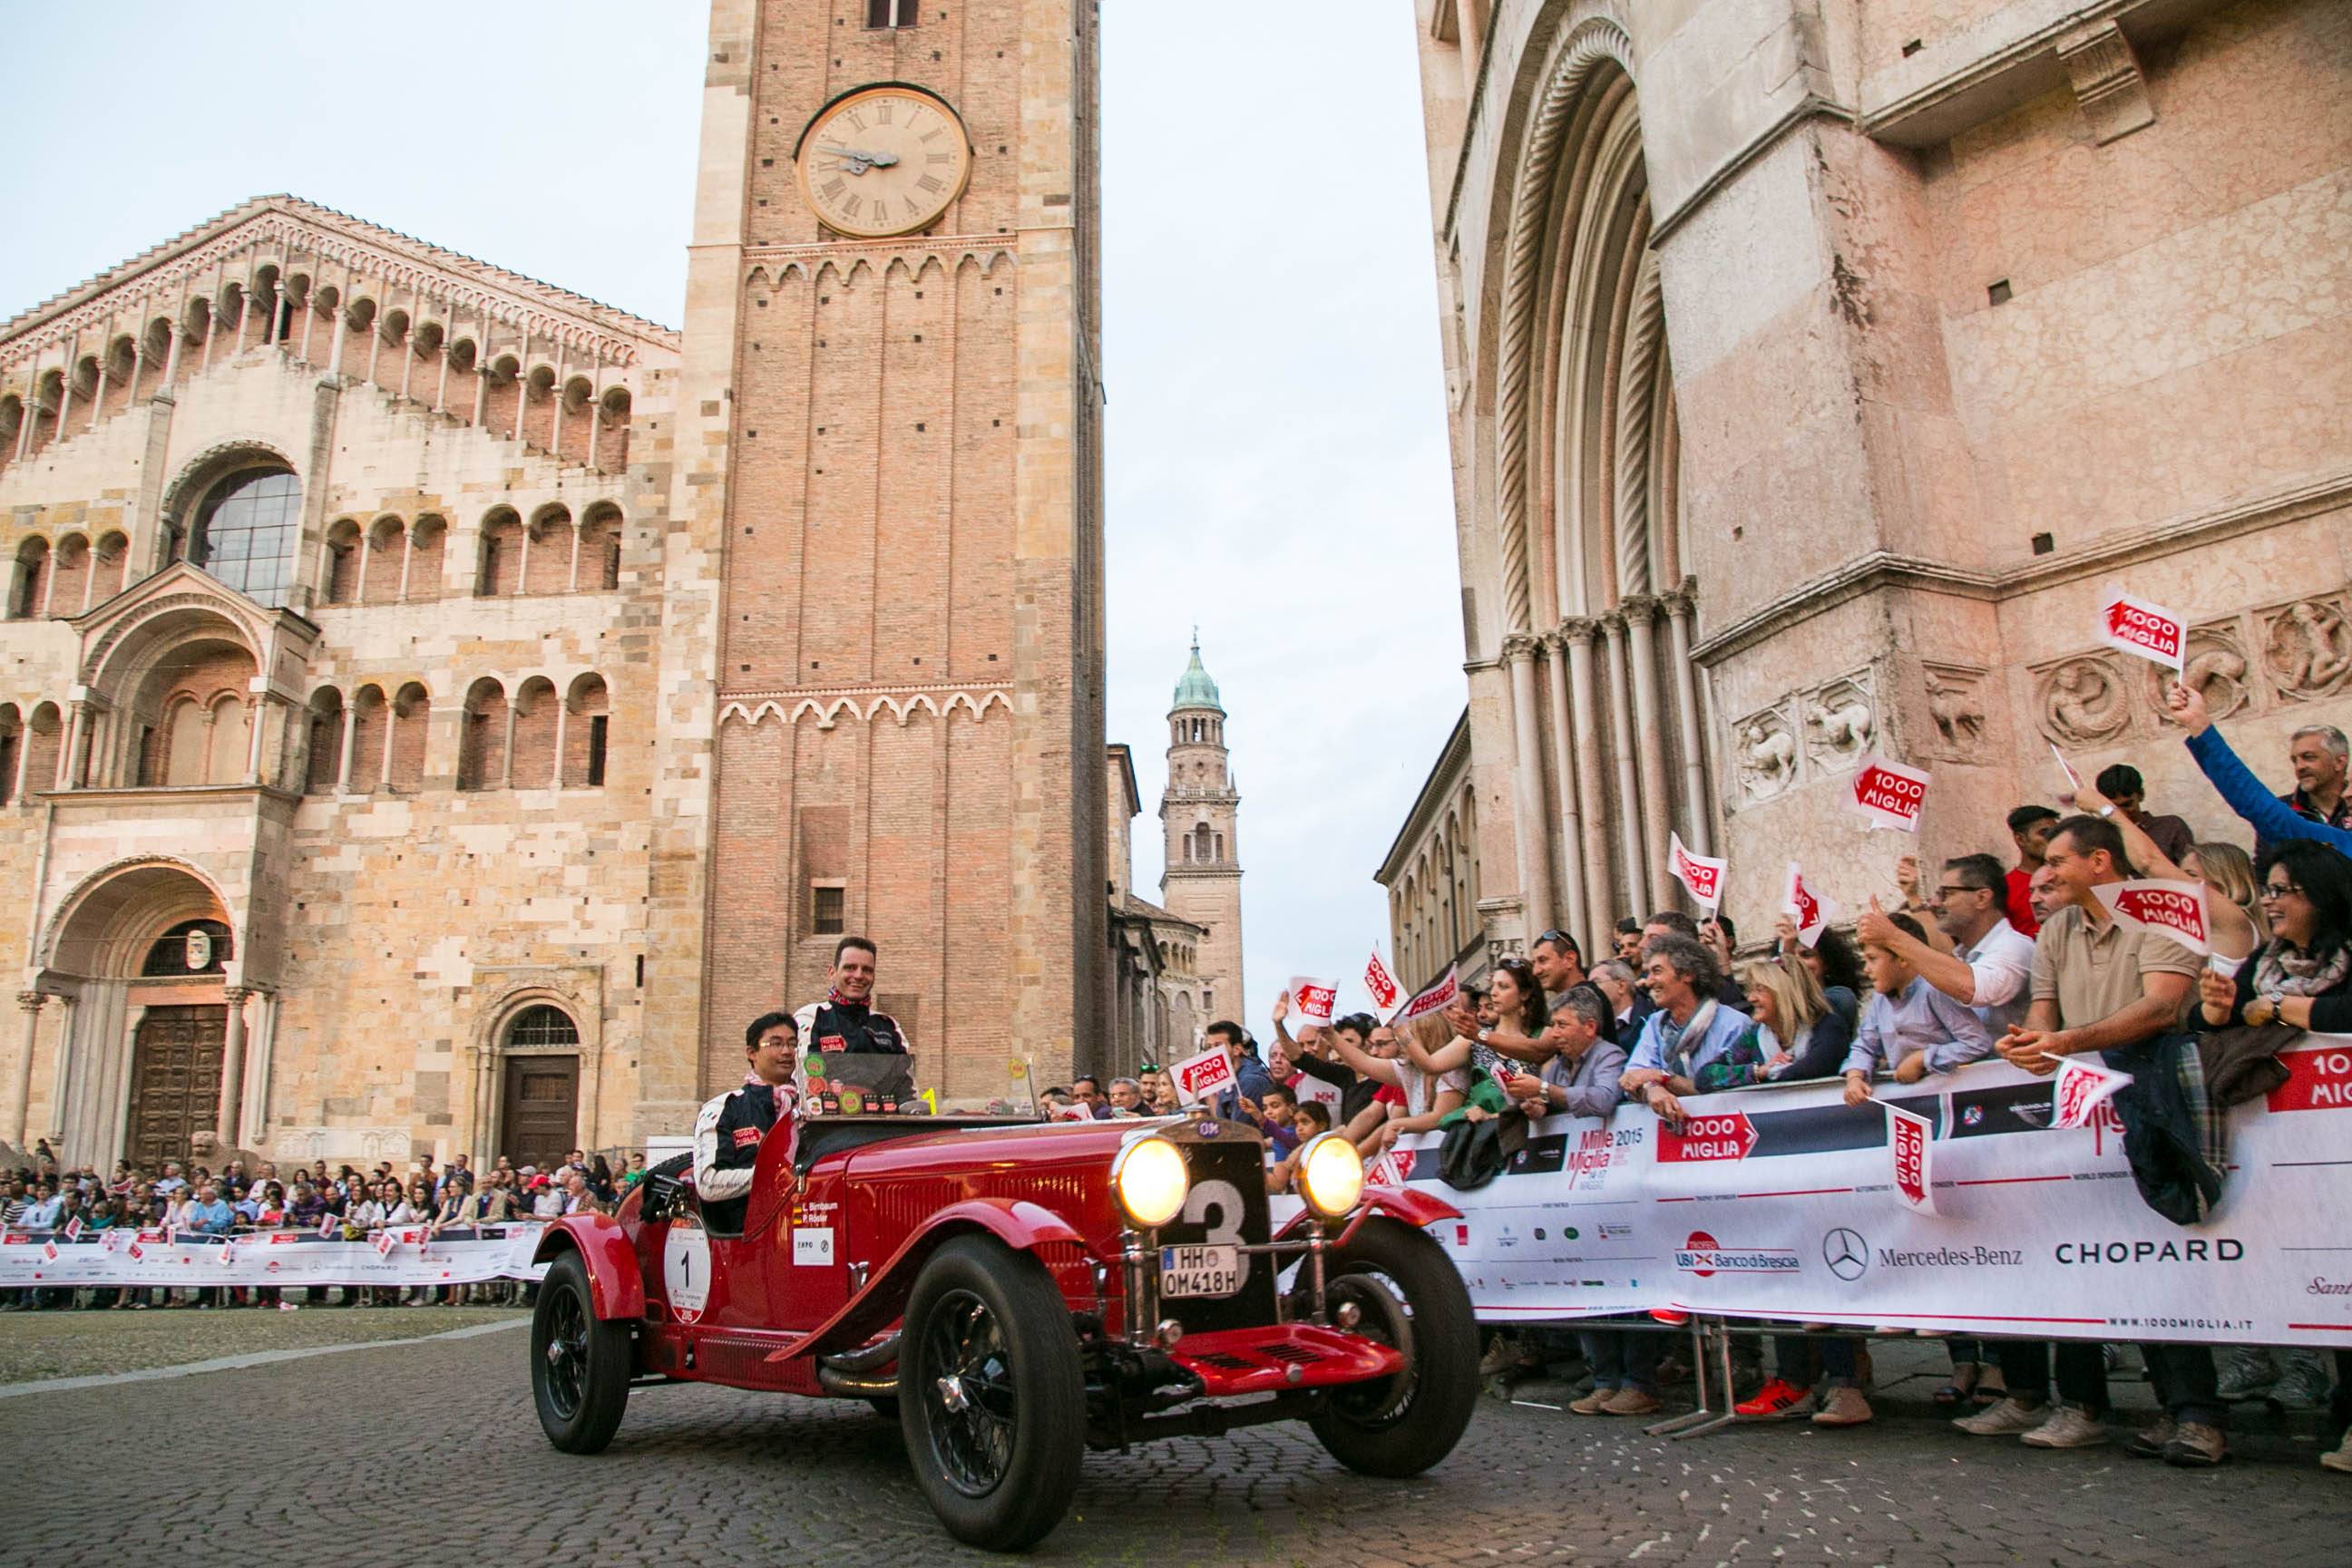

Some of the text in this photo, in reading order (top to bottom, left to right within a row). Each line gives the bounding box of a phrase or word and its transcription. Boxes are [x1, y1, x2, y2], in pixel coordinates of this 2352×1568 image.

[2123, 609, 2175, 636] 1000
[2115, 623, 2175, 654] MIGLIA
[1875, 773, 1922, 798] 1000
[1864, 789, 1919, 815] MIGLIA
[2136, 892, 2193, 913] 1000
[2143, 908, 2201, 937] MIGLIA
[1413, 991, 1454, 1013] MIGLIA
[1417, 982, 1453, 1006] 1000
[1189, 1058, 1222, 1076] 1000
[1314, 1092, 1335, 1102] HH
[1580, 1126, 1644, 1150] Mille 2015
[1682, 1140, 1740, 1159] MIGLIA
[1567, 1151, 1610, 1174] Miglia
[1897, 1120, 1908, 1183] MIGLIA
[1909, 1131, 1921, 1186] 1000
[1181, 1248, 1204, 1269] HH
[1676, 1253, 1693, 1267] UBI
[1879, 1246, 2023, 1268] Mercedes-Benz
[2054, 1239, 2245, 1264] CHOPARD
[681, 1250, 689, 1289] 1
[1166, 1271, 1236, 1295] OM418H
[2108, 1316, 2254, 1330] WWW.1000MIGLIA.IT
